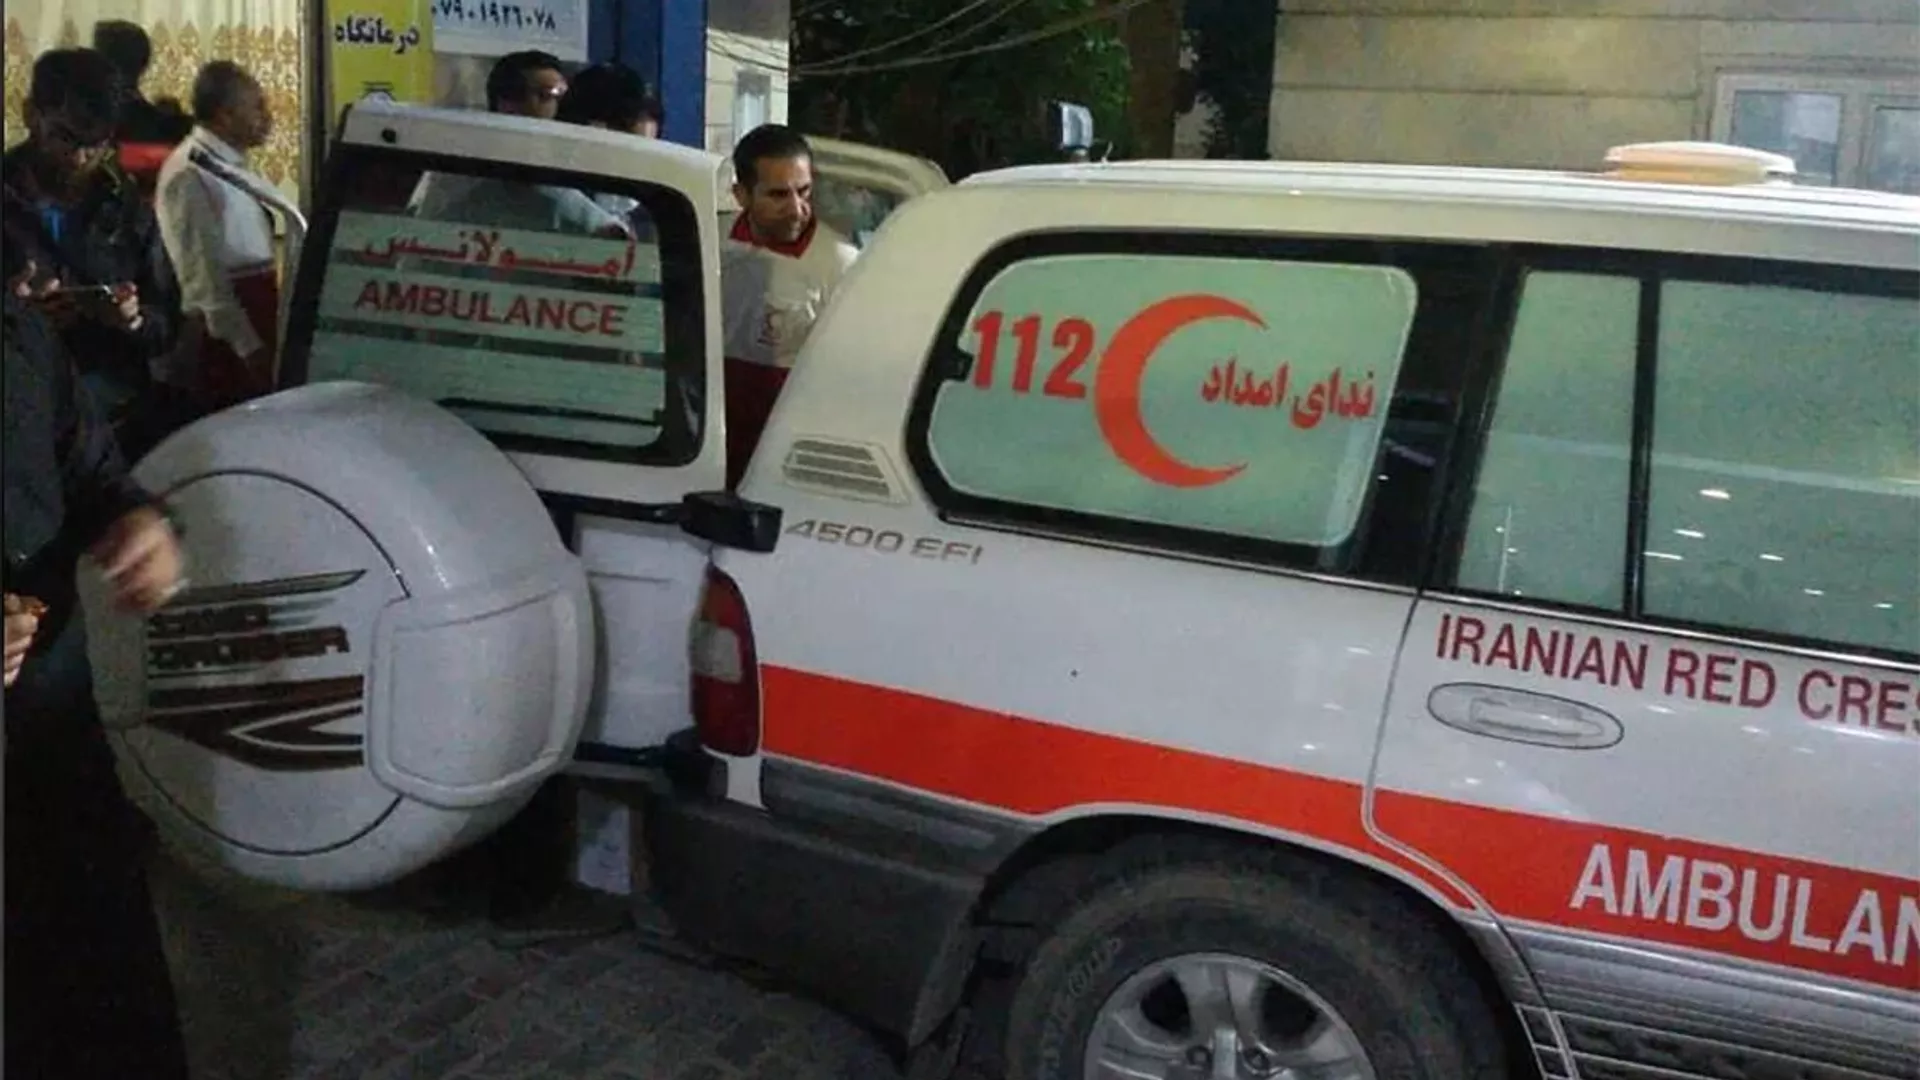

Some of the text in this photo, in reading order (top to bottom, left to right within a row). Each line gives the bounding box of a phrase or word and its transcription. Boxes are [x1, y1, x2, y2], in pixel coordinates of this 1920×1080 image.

[335, 16, 420, 54] درمانگاه
[356, 281, 629, 336] AMBULANCE
[972, 311, 1094, 399] 112
[1202, 359, 1374, 429] ندای امداد
[784, 519, 983, 565] 4500 EFI
[1436, 614, 1920, 736] IRANIAN RED CRE
[1568, 844, 1920, 966] AMBULAN
